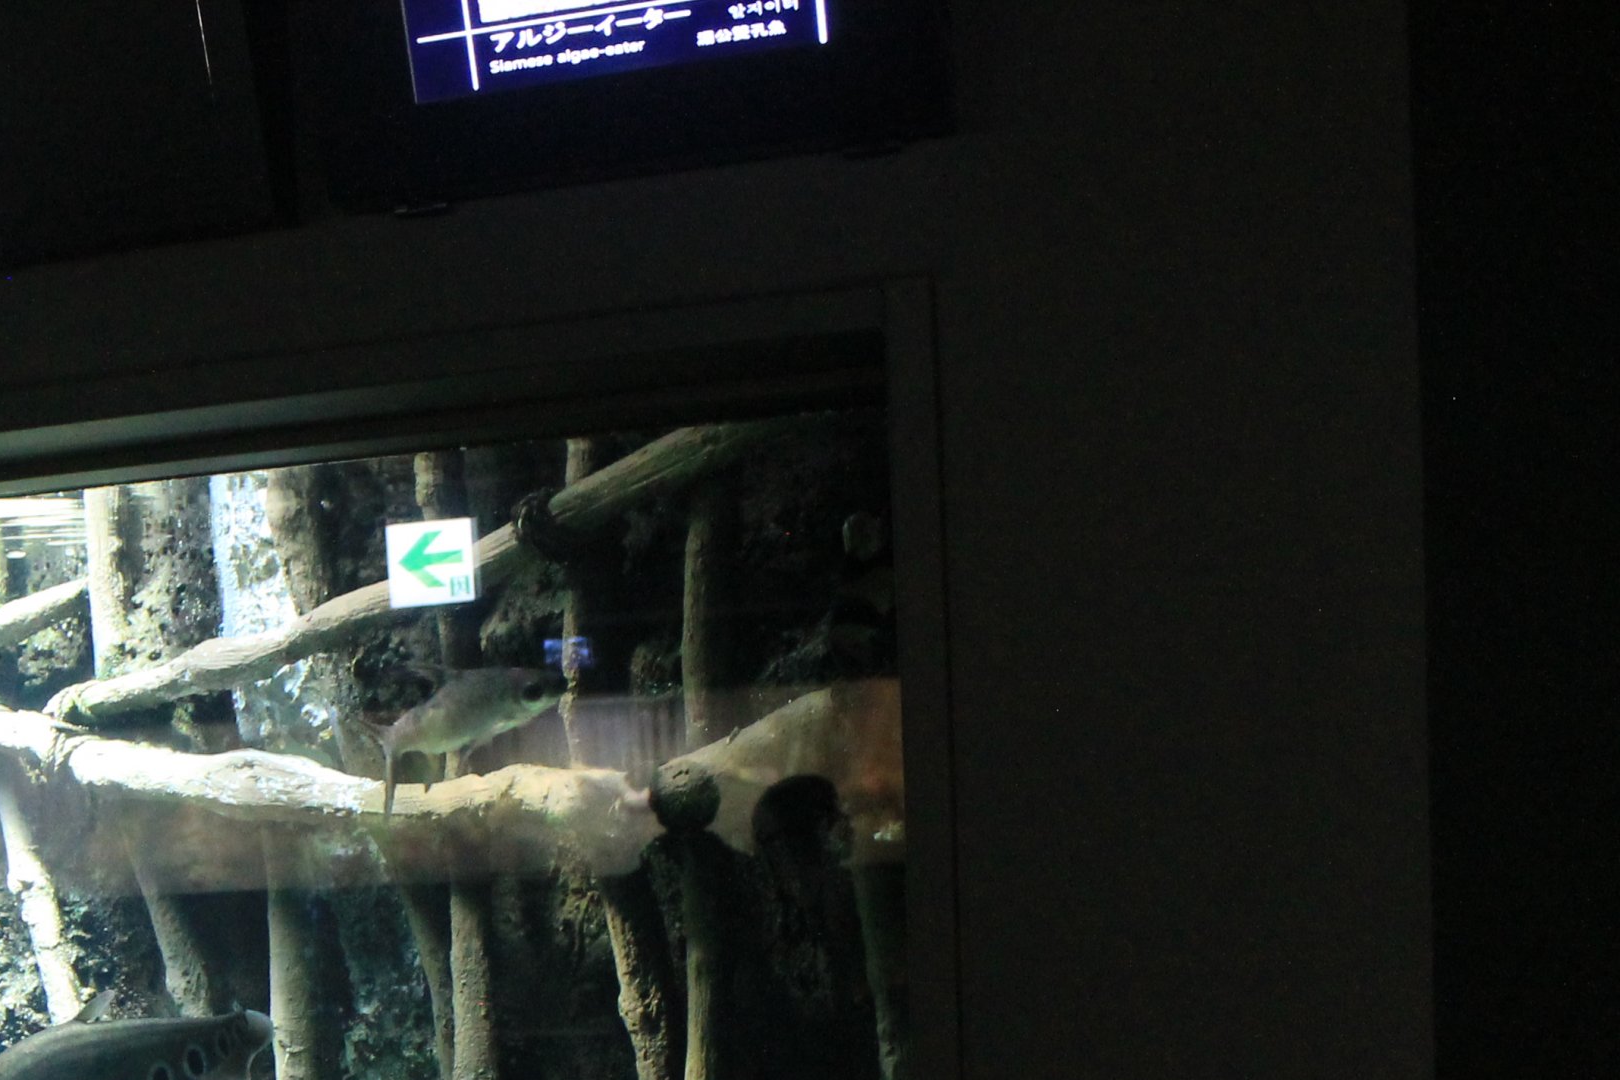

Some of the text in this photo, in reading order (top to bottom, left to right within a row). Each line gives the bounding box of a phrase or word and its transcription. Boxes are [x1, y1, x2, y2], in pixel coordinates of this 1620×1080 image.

[489, 8, 692, 53] アルジーイーター
[489, 38, 646, 75] Siamese algae-eater
